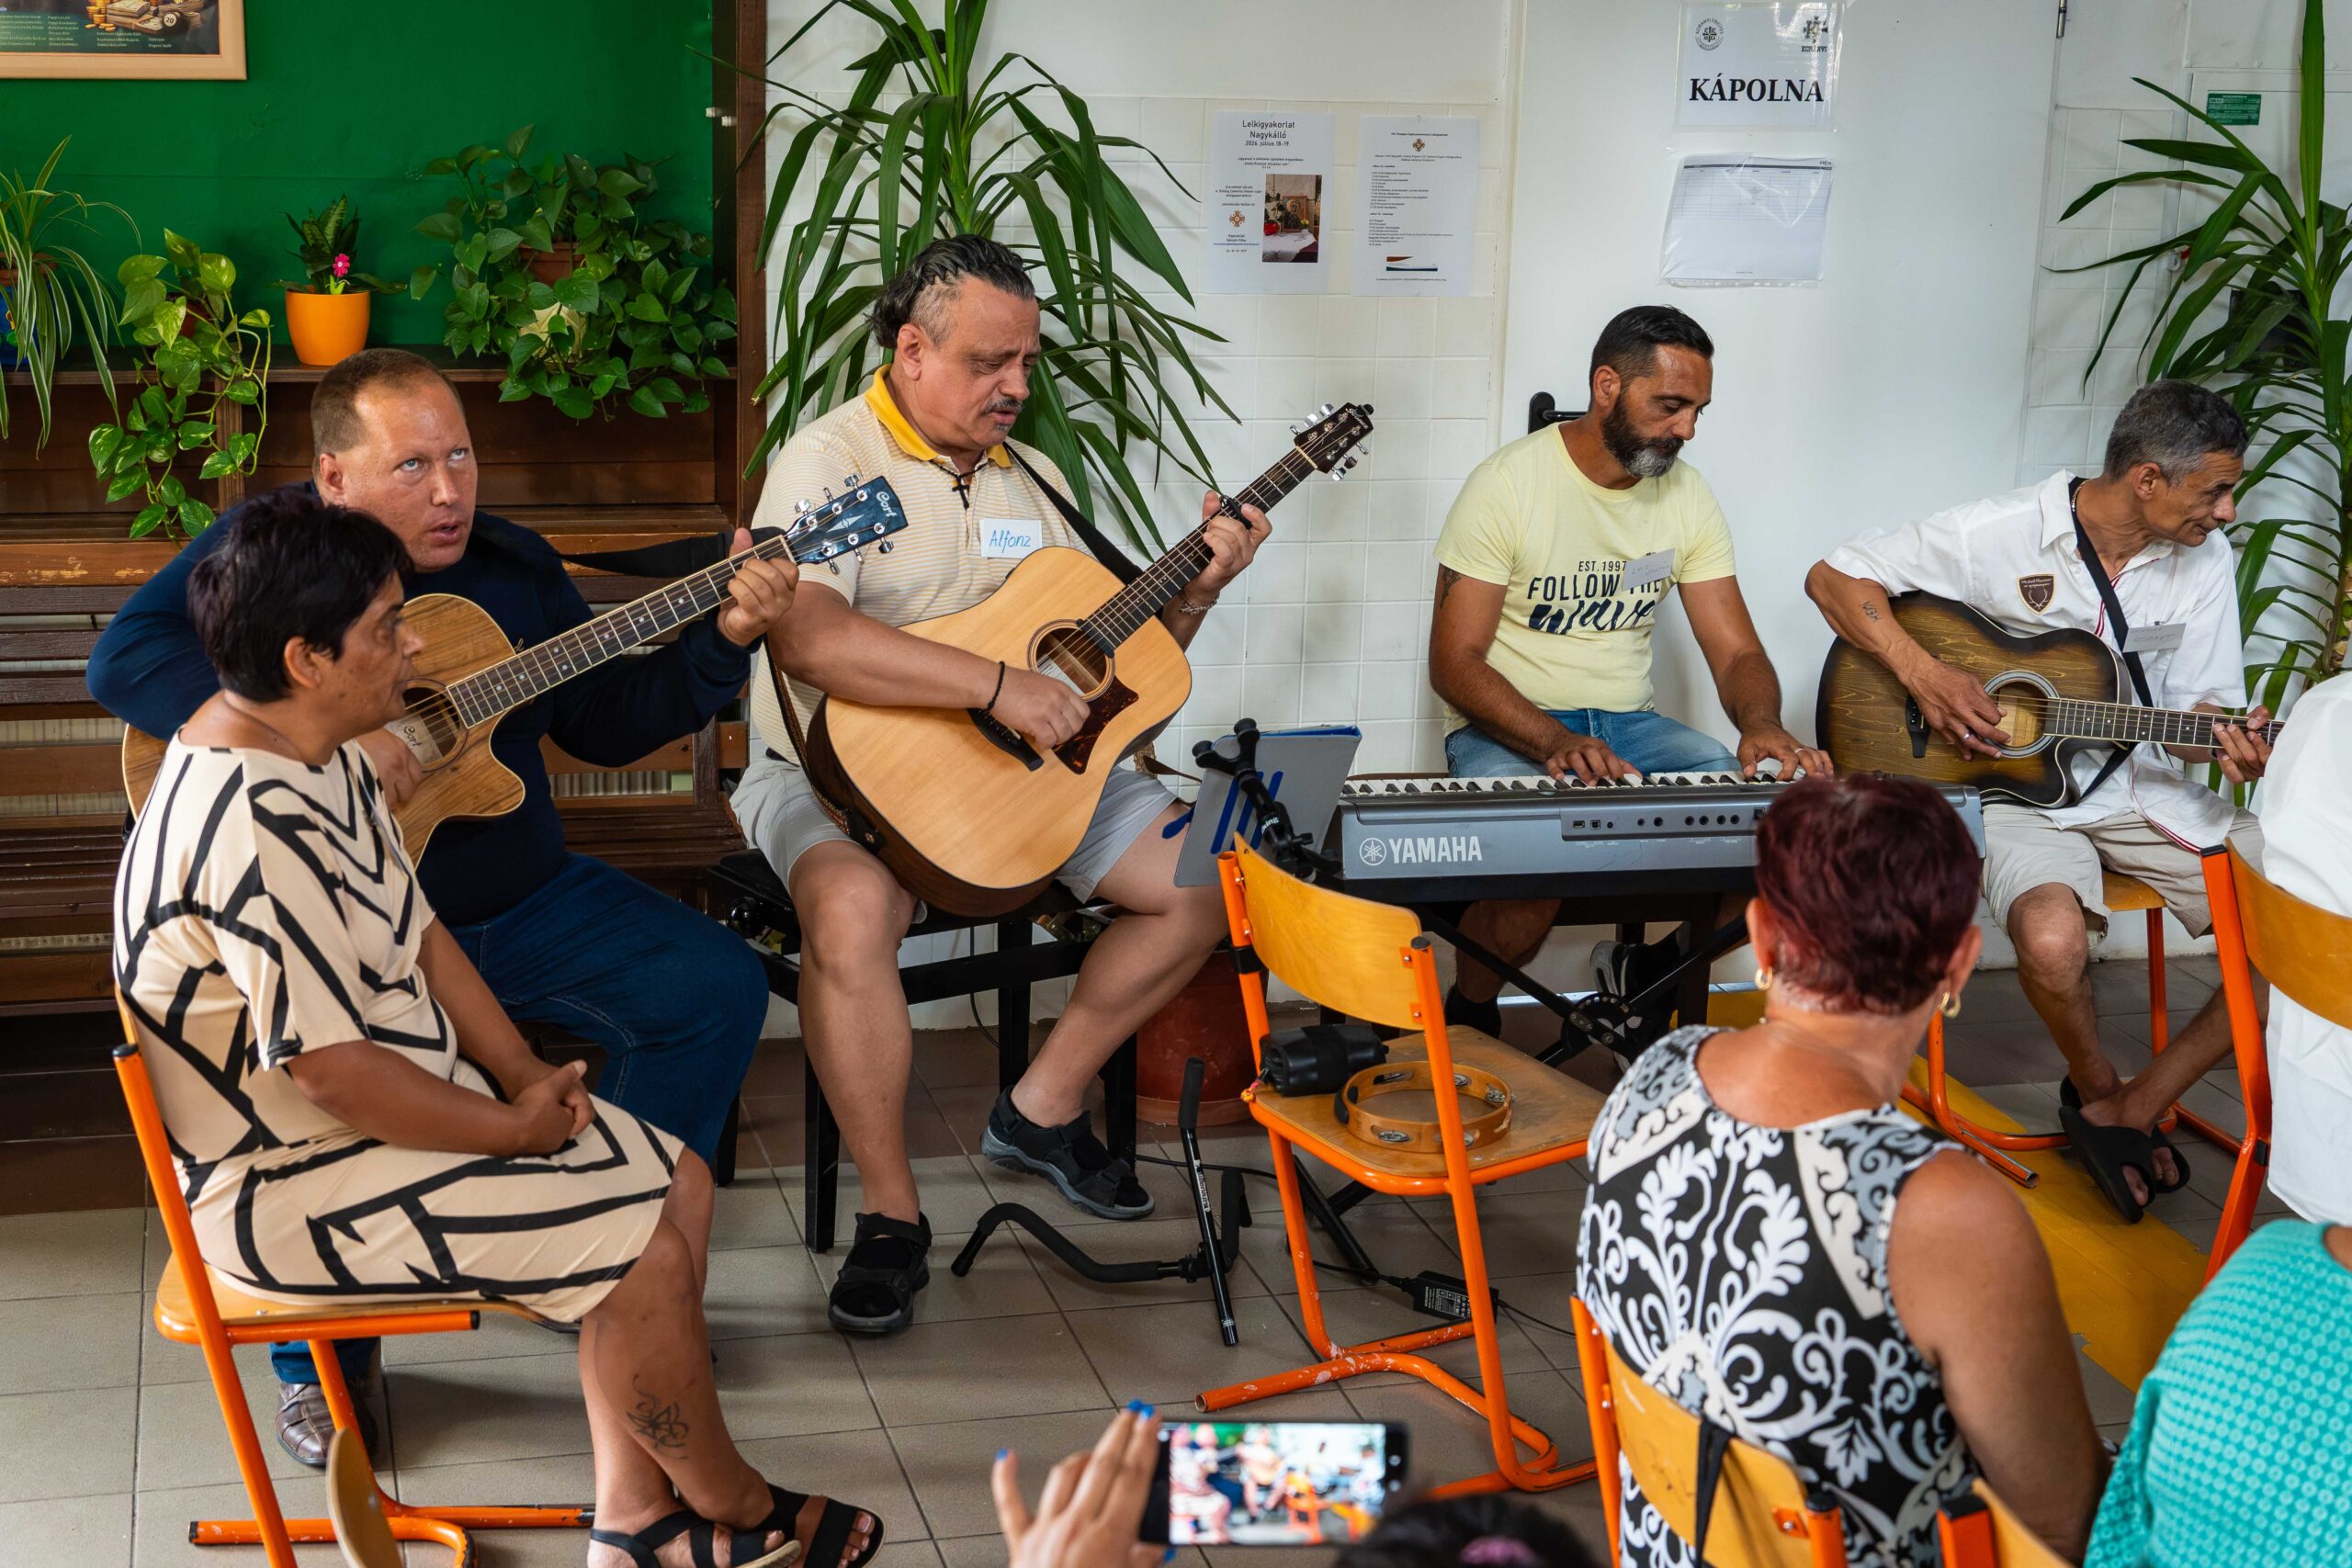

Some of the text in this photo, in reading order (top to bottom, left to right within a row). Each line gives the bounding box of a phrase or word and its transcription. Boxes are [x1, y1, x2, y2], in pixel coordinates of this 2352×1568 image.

[1689, 73, 1824, 102] KÁPOLNA
[1242, 120, 1295, 130] Lelkigyakorlat
[1250, 130, 1286, 140] Nagykálló
[876, 491, 898, 518] Cort
[989, 529, 1031, 553] Alfonz
[1527, 573, 1620, 602] FOLLOW
[403, 725, 422, 747] Cort
[1389, 836, 1483, 863] YAMAHA
